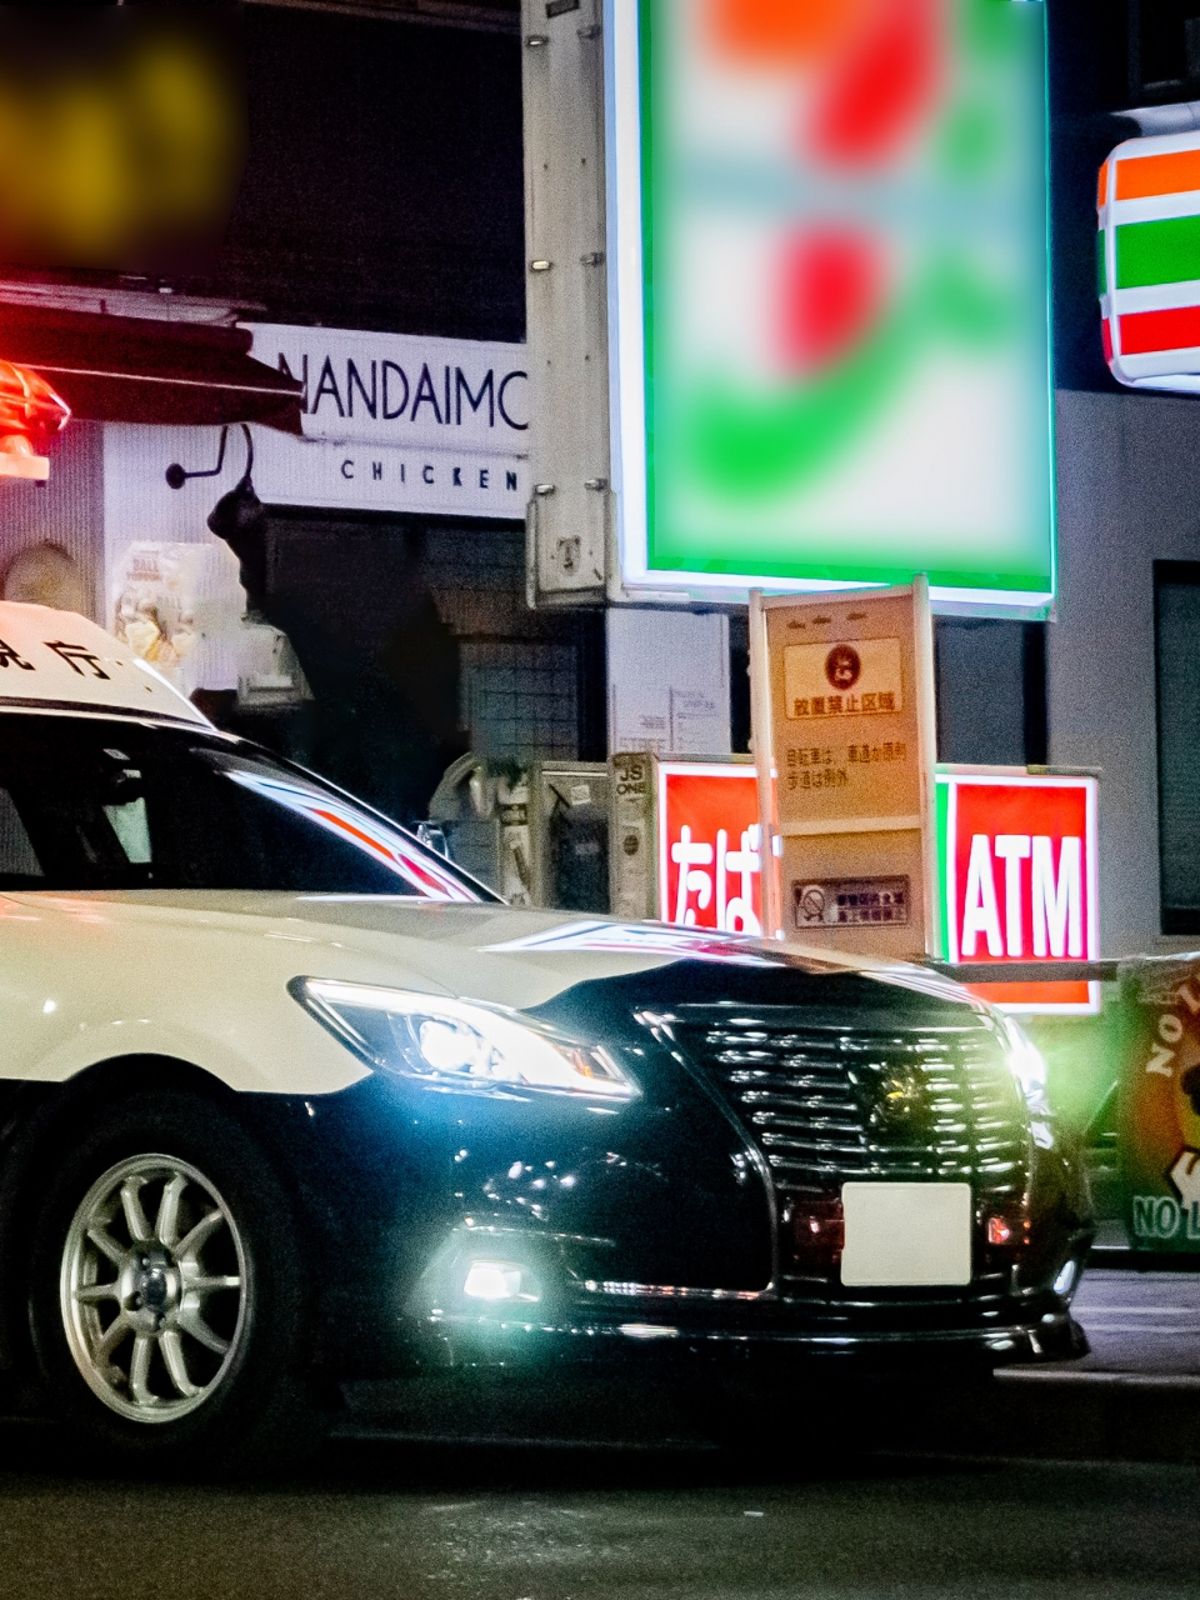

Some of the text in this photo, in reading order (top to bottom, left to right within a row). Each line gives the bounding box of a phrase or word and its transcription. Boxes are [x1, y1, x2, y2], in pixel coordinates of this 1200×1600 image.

[341, 459, 518, 492] CHICKEN
[616, 782, 647, 796] ONE
[619, 765, 643, 782] JS
[961, 833, 1084, 958] ATM
[1145, 1014, 1183, 1078] NO
[1133, 1196, 1181, 1239] NO
